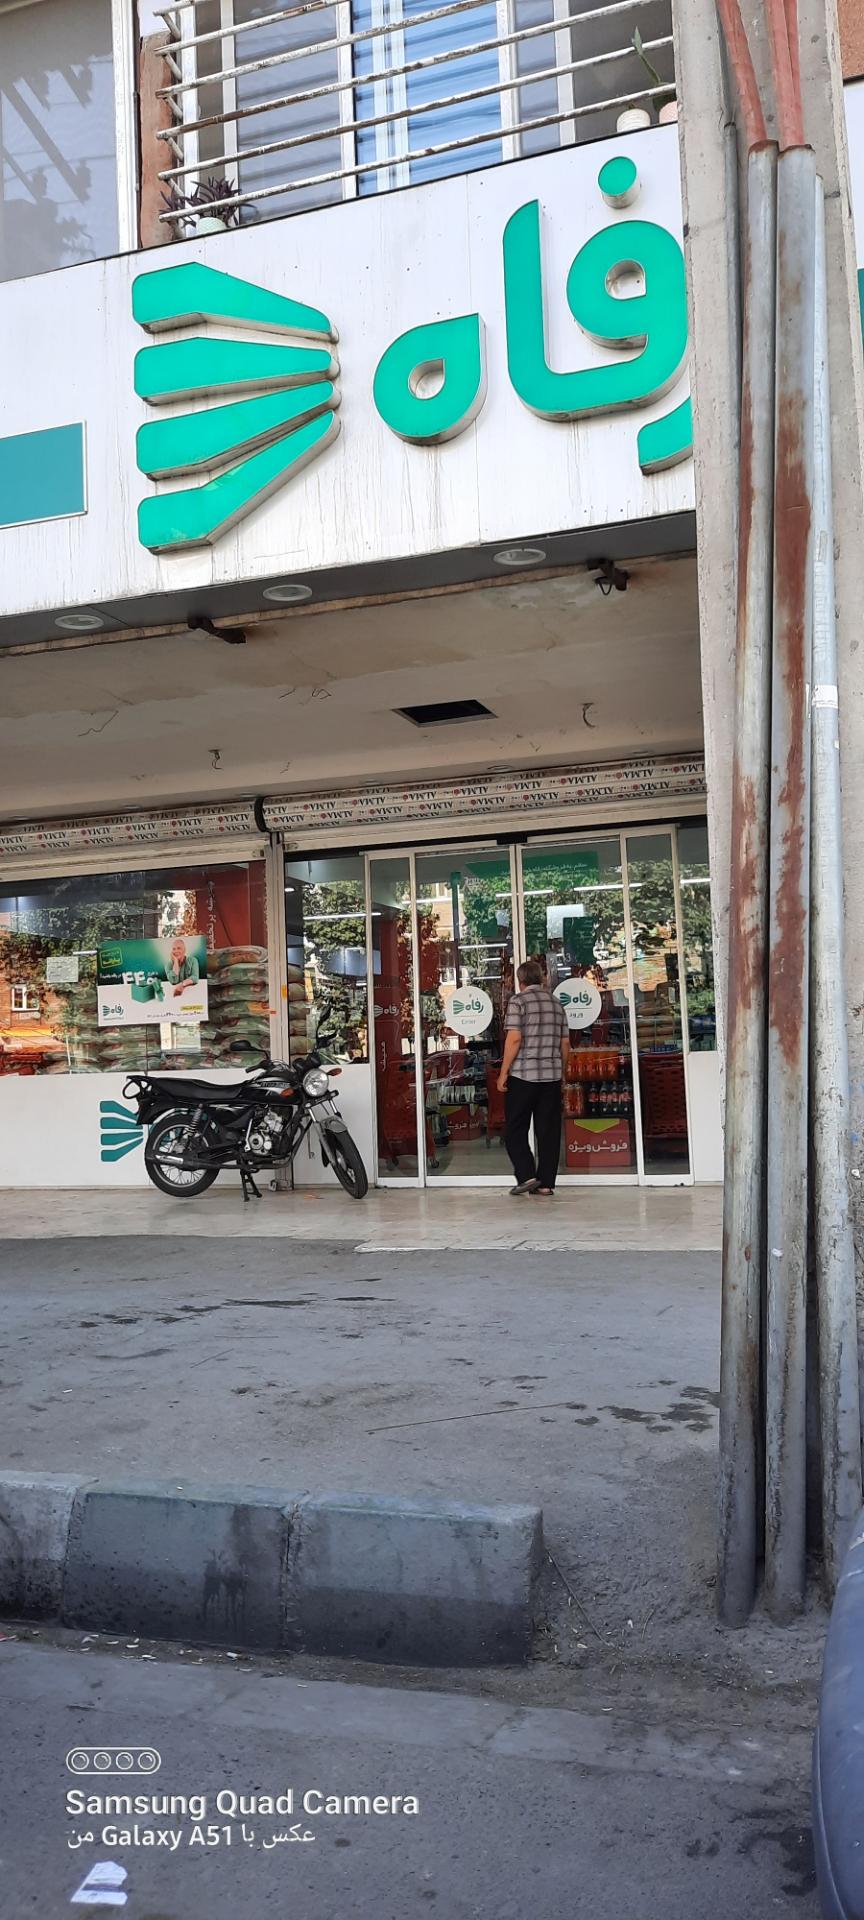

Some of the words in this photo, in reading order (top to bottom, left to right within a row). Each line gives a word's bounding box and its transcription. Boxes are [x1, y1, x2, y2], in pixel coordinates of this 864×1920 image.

[310, 801, 336, 810] ALMA
[360, 797, 386, 805] ALMA
[410, 791, 437, 800] ALMA
[460, 786, 489, 795] ALMA
[514, 780, 543, 790] ALMA
[568, 775, 598, 784] ALMA
[624, 769, 654, 778] ALMA
[681, 764, 704, 773] LMA
[326, 810, 353, 818] ALMA
[376, 806, 403, 815] ALMA
[427, 801, 453, 810] ALMA
[477, 796, 505, 805] ALMA
[531, 792, 560, 800] ALMA
[585, 787, 614, 795] ALMA
[640, 781, 671, 790] ALMA
[465, 998, 484, 1014] رفاه
[572, 990, 592, 1006] رفاه
[568, 1140, 591, 1152] ویژه
[592, 1139, 628, 1152] فروش
